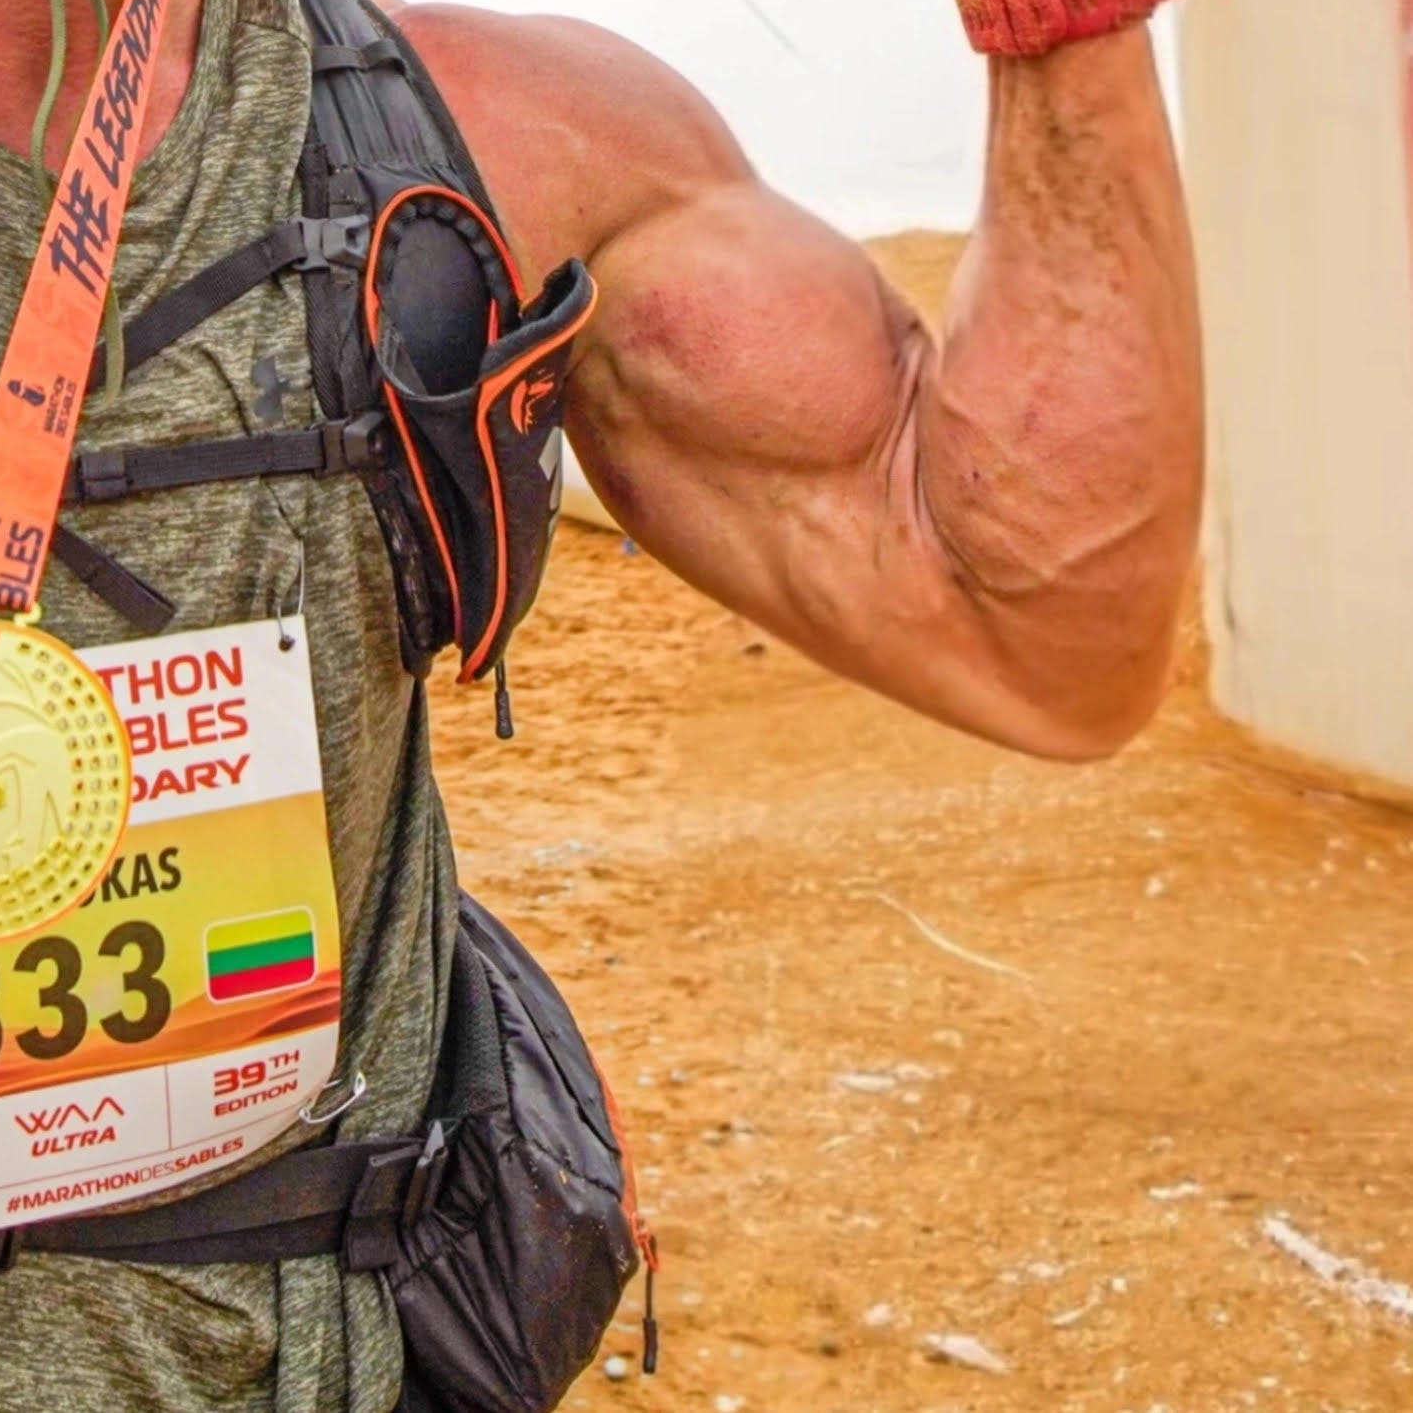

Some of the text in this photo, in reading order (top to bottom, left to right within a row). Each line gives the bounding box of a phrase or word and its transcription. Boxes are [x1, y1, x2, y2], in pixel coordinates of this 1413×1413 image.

[48, 167, 110, 300] THE
[42, 374, 66, 434] MARATHON
[54, 416, 68, 438] DES
[125, 698, 249, 756] BLES
[83, 847, 182, 908] KAS
[213, 1079, 299, 1118] EDITION
[31, 1126, 117, 1158] ULTRA
[6, 1136, 245, 1214] #MARATHONDESSABLES
